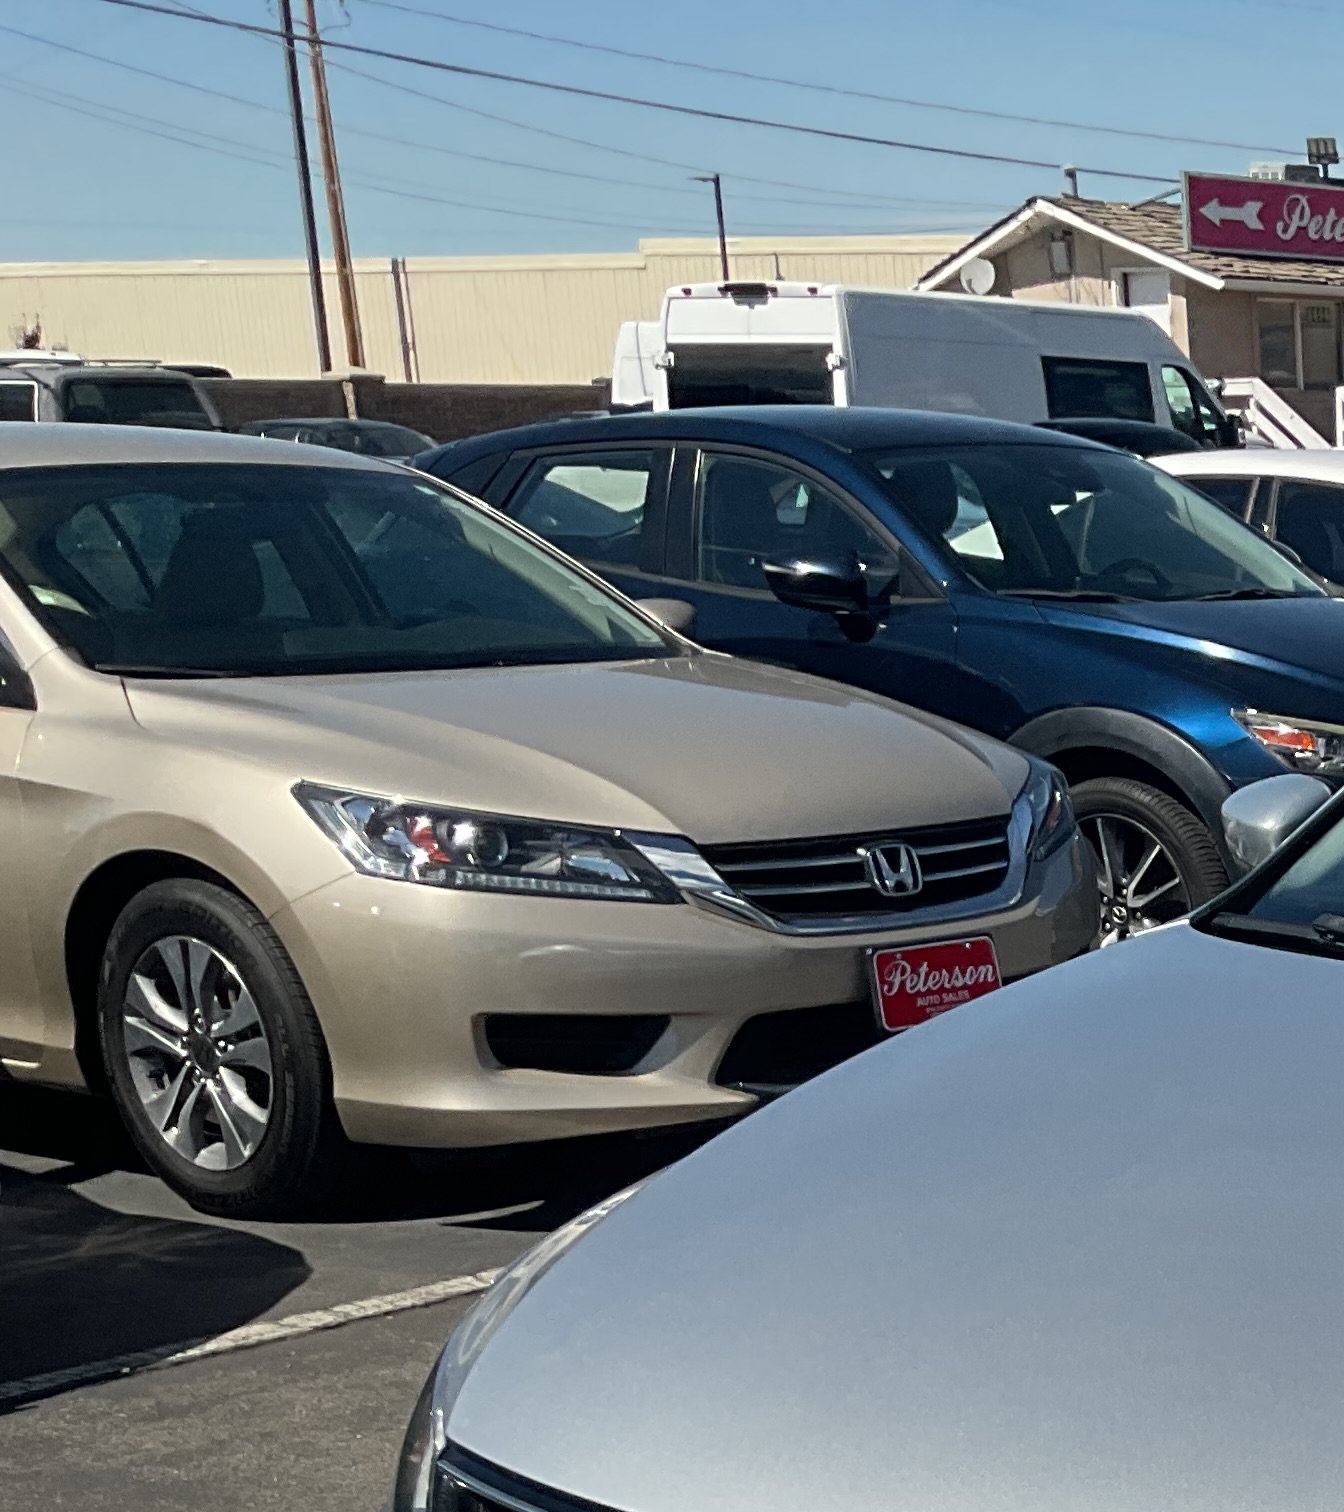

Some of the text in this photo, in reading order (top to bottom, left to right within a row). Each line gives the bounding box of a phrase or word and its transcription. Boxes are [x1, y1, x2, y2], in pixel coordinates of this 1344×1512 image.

[884, 960, 995, 996] Peterson
[917, 990, 970, 1007] AUTO SALES
